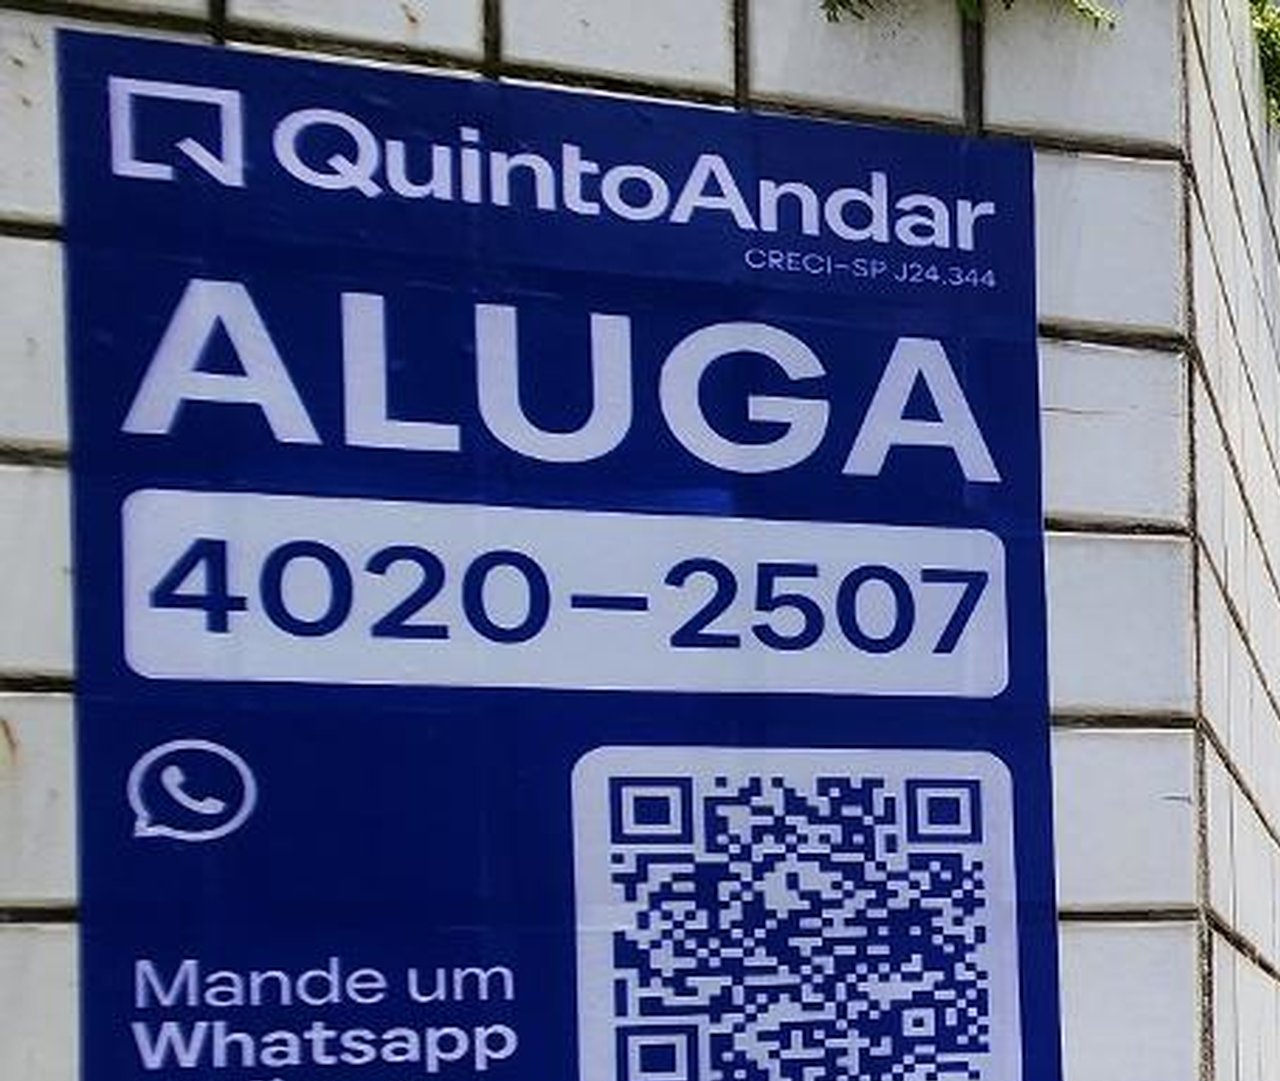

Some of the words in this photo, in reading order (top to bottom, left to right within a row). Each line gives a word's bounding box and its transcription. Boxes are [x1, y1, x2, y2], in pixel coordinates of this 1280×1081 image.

[272, 107, 996, 252] QuintoAndar
[744, 249, 888, 279] CRECI-SP
[894, 262, 997, 288] J24.344
[121, 277, 1002, 484] ALUGA
[148, 536, 990, 656] 4020-2507
[134, 956, 388, 1008] Mande
[407, 966, 515, 1003] um
[131, 1020, 519, 1074] Whatsapp
